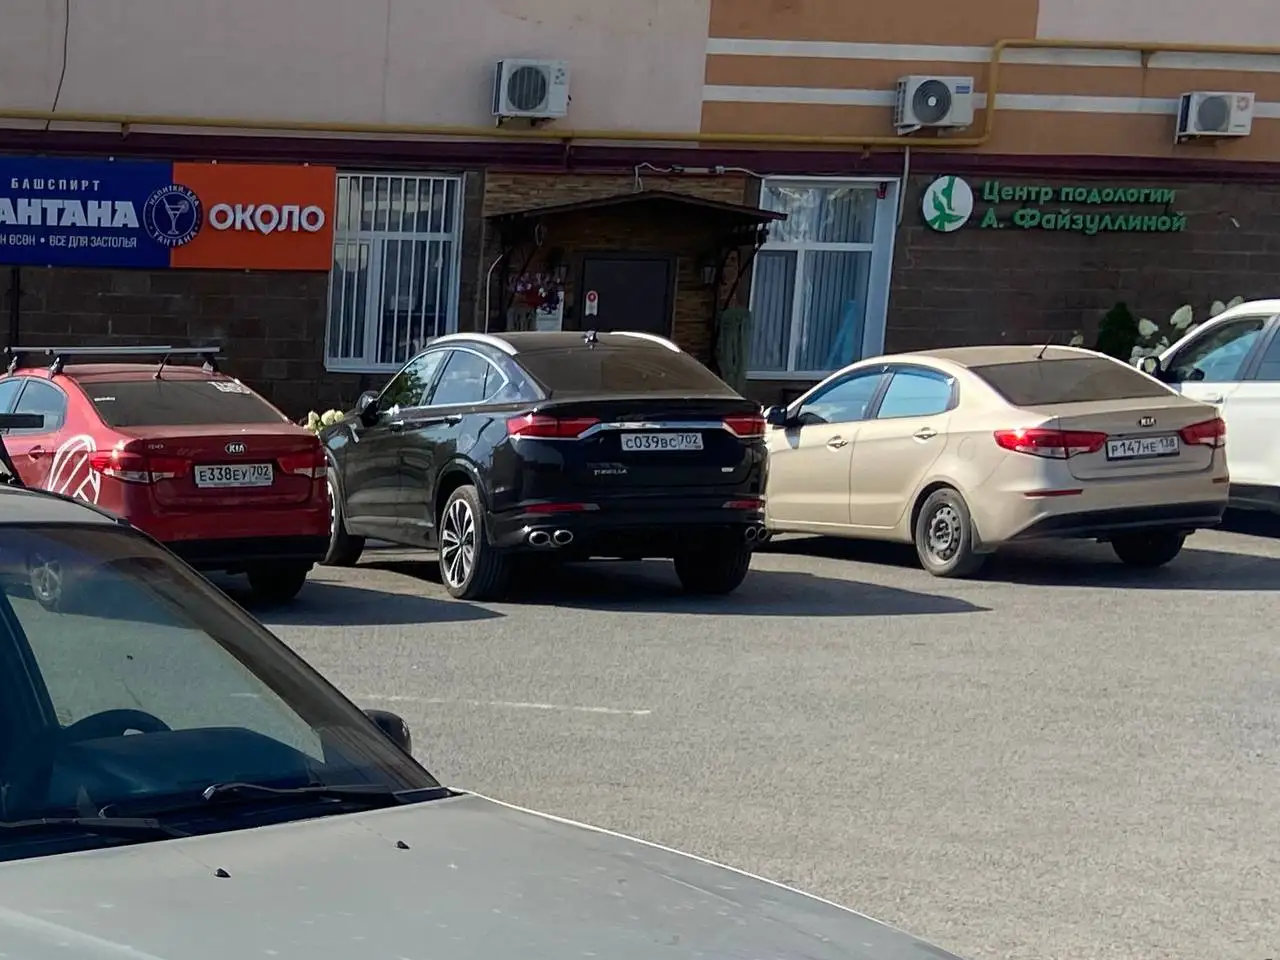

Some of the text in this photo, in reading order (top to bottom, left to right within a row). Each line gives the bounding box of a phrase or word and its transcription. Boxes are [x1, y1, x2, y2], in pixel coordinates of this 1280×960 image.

[11, 177, 101, 192] БАШСПИРТ
[982, 181, 1176, 205] Центр подологии
[209, 203, 325, 235] ОКОЛО
[982, 208, 1187, 235] А. Файзуллиной
[68, 236, 88, 248] ДЛЯ
[90, 236, 137, 248] ЗАСТОЛЬЯ
[228, 444, 245, 454] KIA
